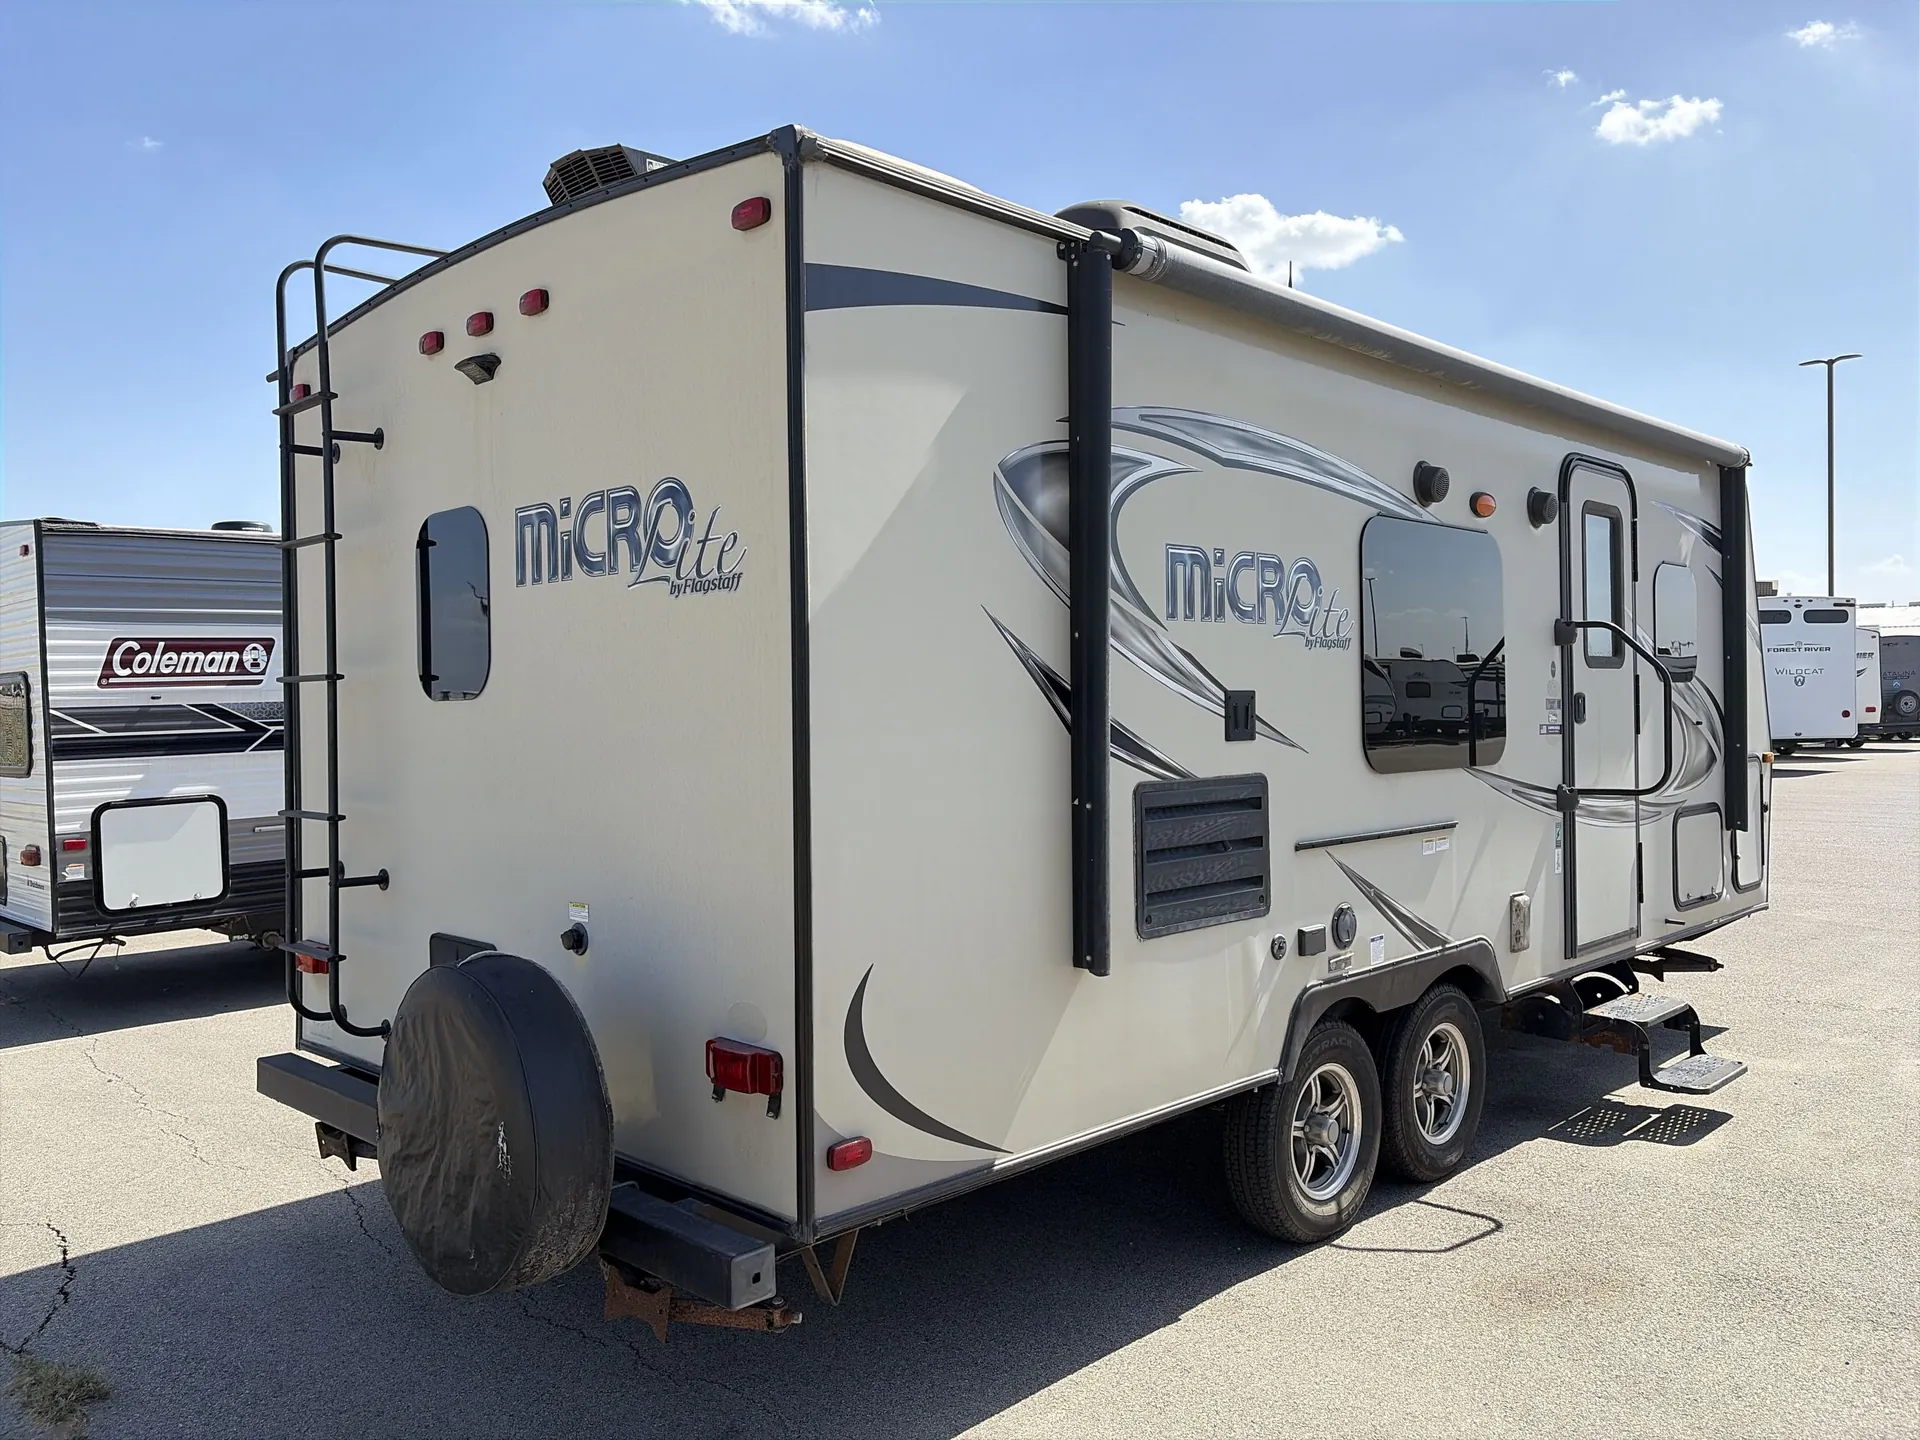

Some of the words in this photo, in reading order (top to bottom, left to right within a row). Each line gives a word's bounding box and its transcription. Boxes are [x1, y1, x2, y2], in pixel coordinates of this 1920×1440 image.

[627, 498, 747, 590] Lite
[669, 579, 683, 598] by
[683, 572, 743, 596] Flagstaff
[1273, 573, 1355, 639] Lite
[111, 639, 241, 677] Coleman
[1315, 636, 1353, 651] Flagstaff
